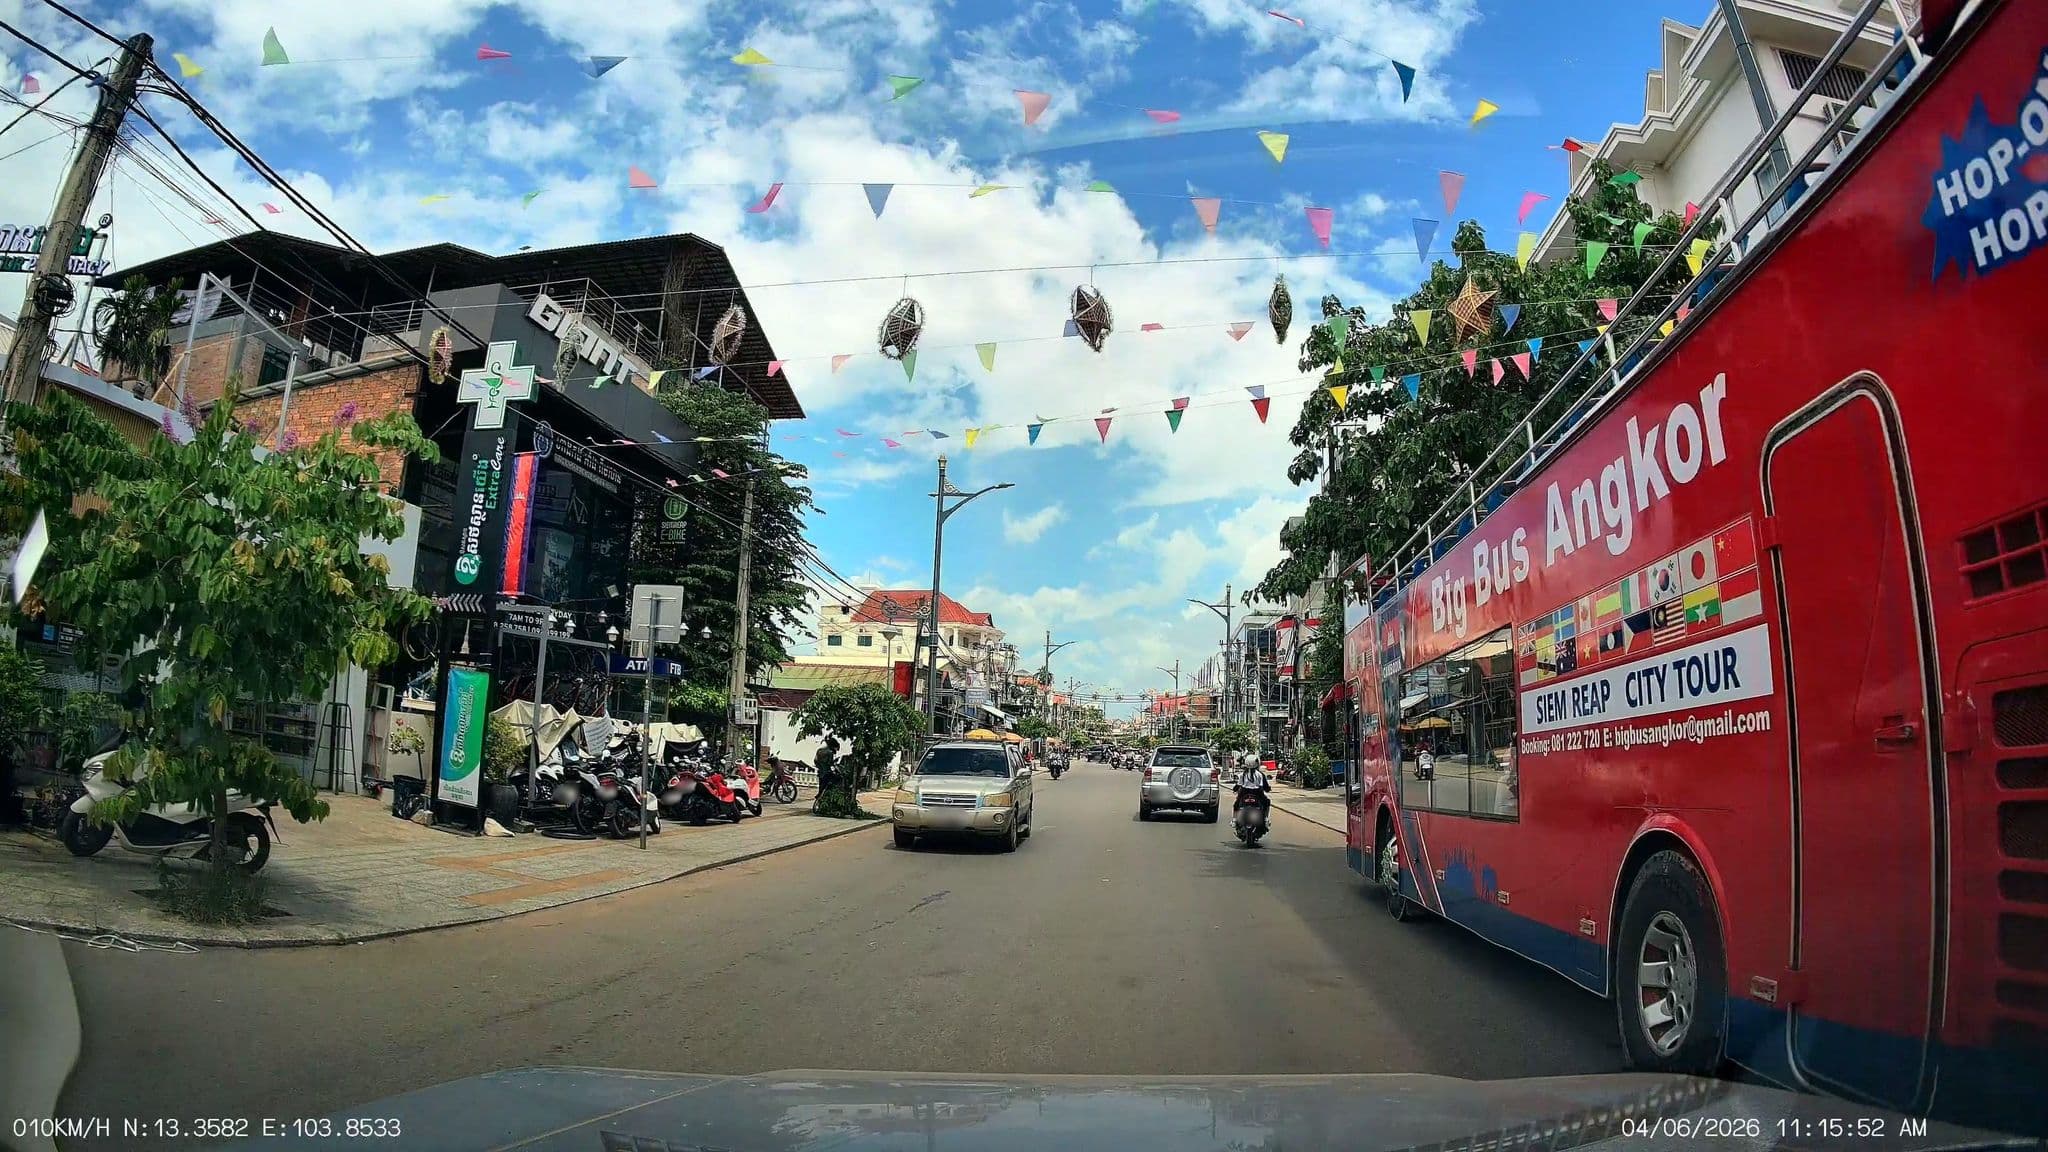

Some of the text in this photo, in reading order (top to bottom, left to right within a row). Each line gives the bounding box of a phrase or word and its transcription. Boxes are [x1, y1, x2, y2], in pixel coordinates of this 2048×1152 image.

[1969, 189, 2048, 268] HOP
[29, 255, 110, 275] PMACY
[1431, 372, 1727, 639] Big Bus Angkor
[508, 613, 524, 622] 7AM
[524, 615, 535, 624] TO
[1537, 646, 1740, 725] SIEM REAP CITY TOUR
[1521, 709, 1771, 757] Booking: 081 222 720 E: bigbusangkor@gmail.com
